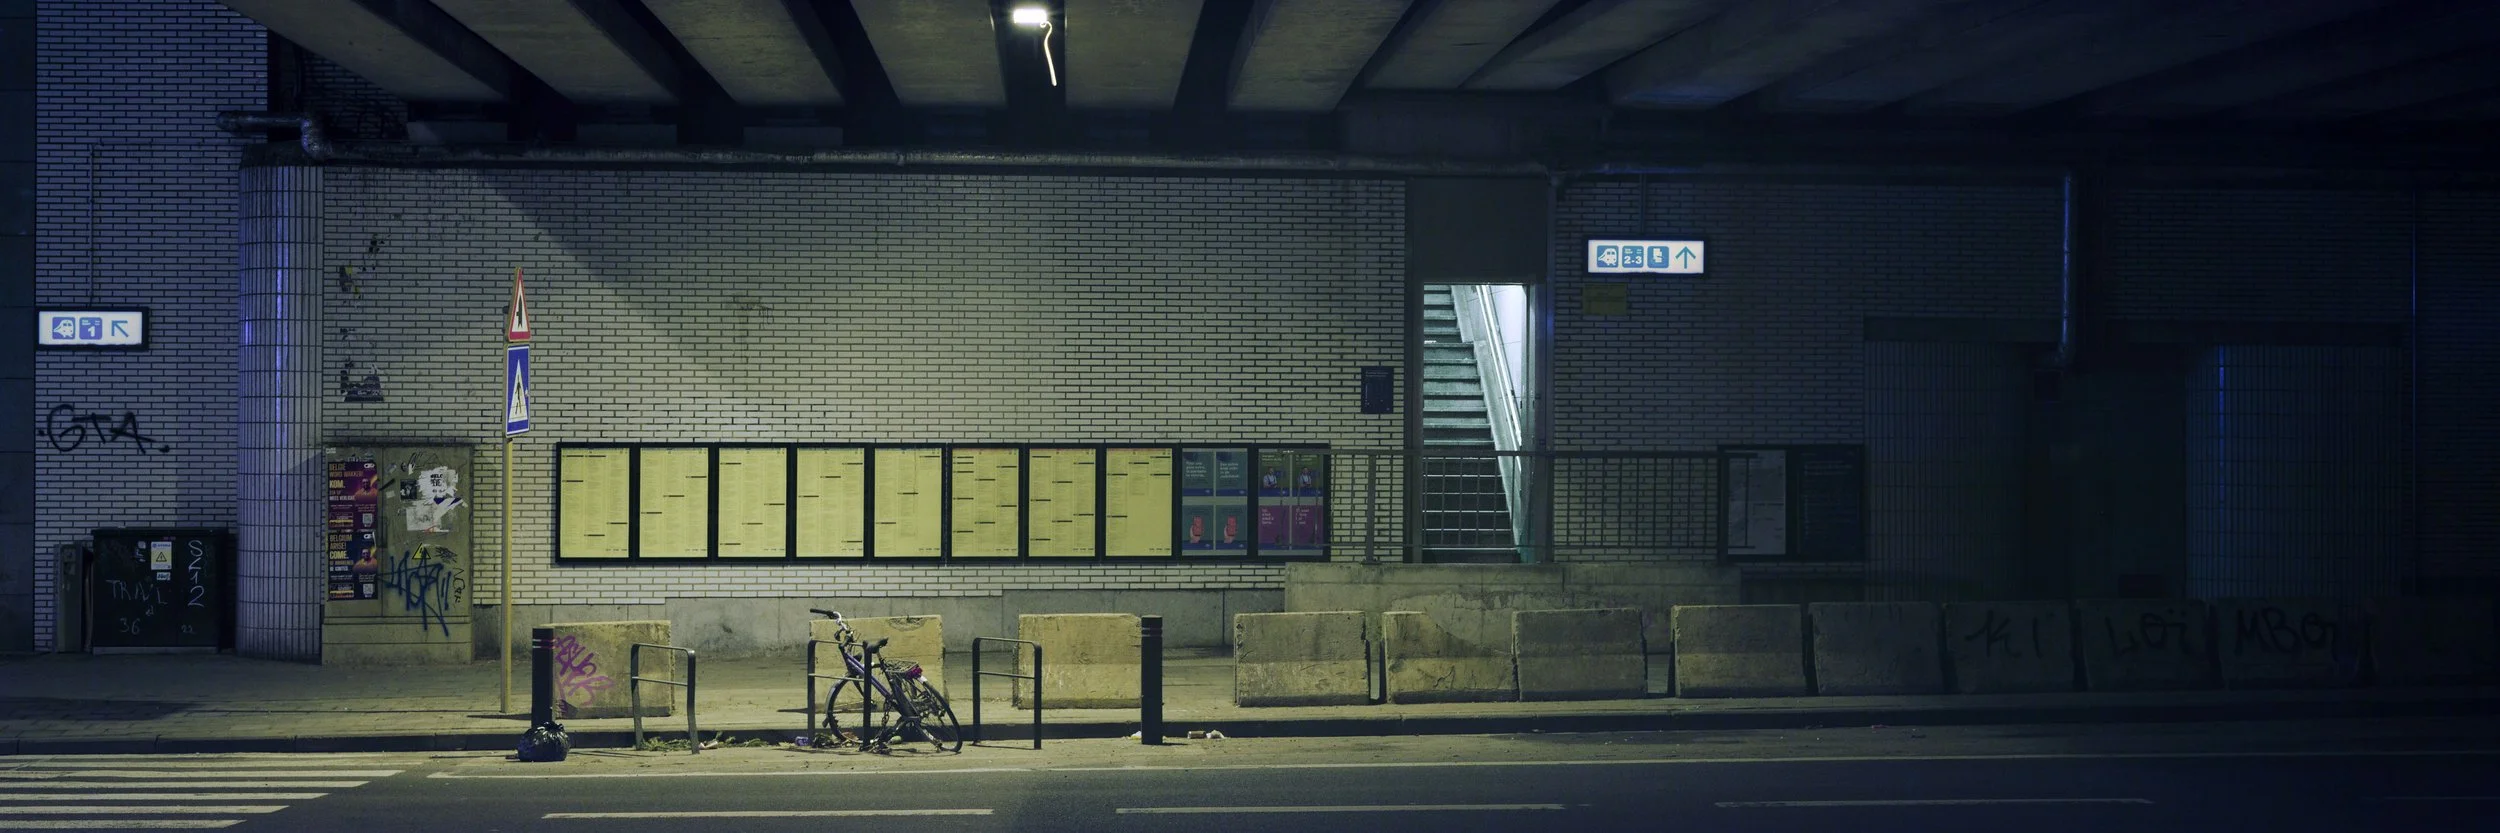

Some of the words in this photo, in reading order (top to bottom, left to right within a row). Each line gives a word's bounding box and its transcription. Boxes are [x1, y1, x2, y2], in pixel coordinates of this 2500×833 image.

[1624, 255, 1643, 264] 2-3
[87, 325, 96, 337] 1
[329, 479, 346, 489] KOM.
[329, 550, 350, 560] COME.
